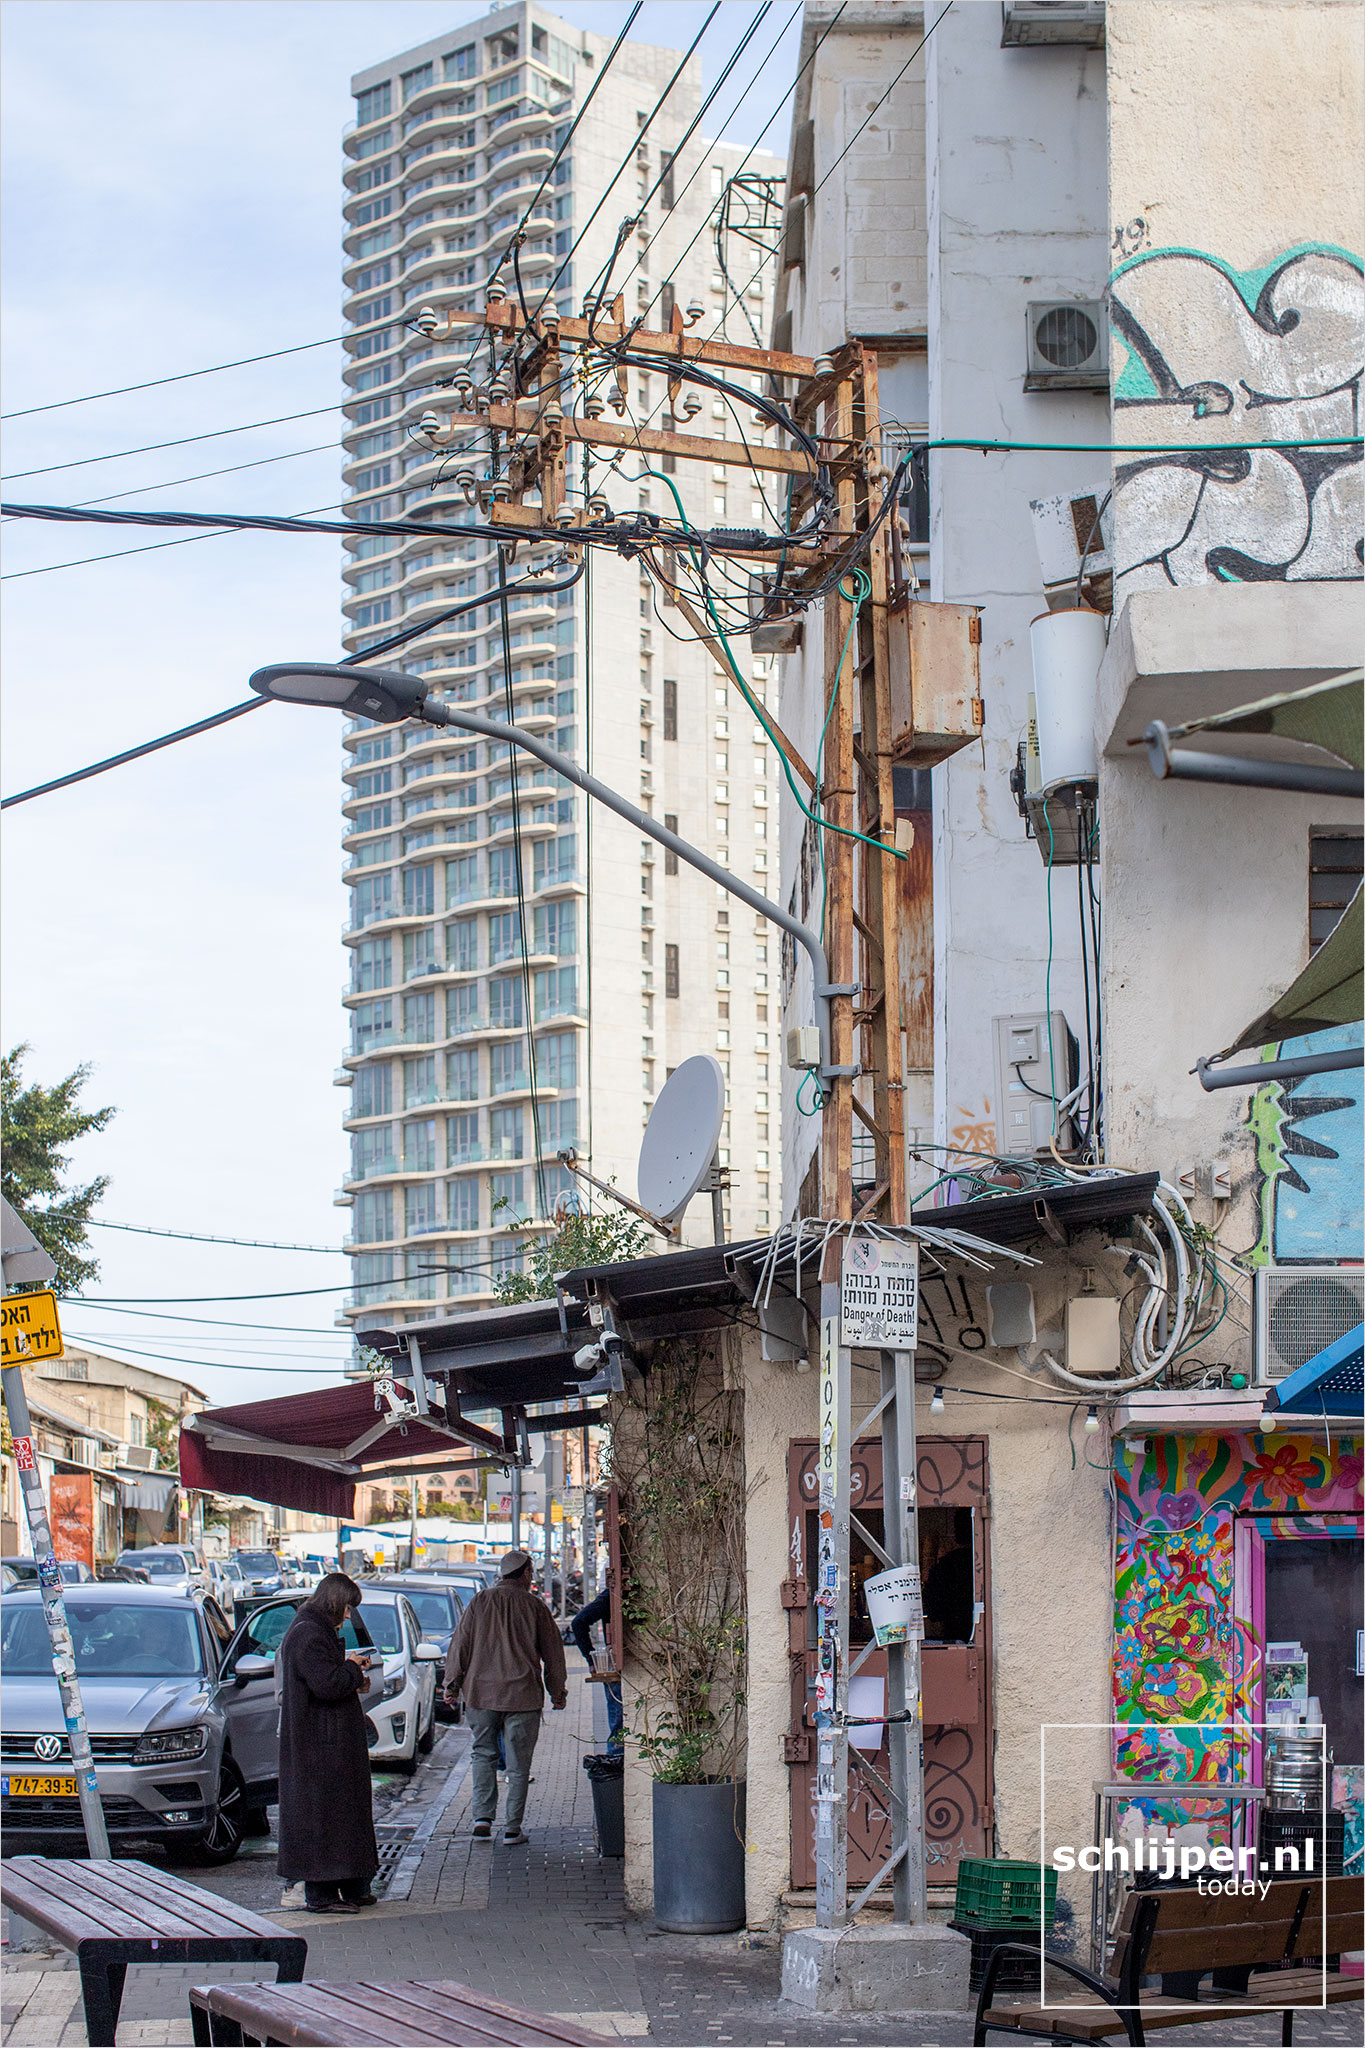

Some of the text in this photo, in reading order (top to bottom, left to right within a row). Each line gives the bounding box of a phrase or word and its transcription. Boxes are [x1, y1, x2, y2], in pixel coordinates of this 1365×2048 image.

[846, 1273, 915, 1291] מתח גבוה!
[844, 1289, 915, 1307] סכנת מוות!
[843, 1306, 915, 1323] Danger of Death!
